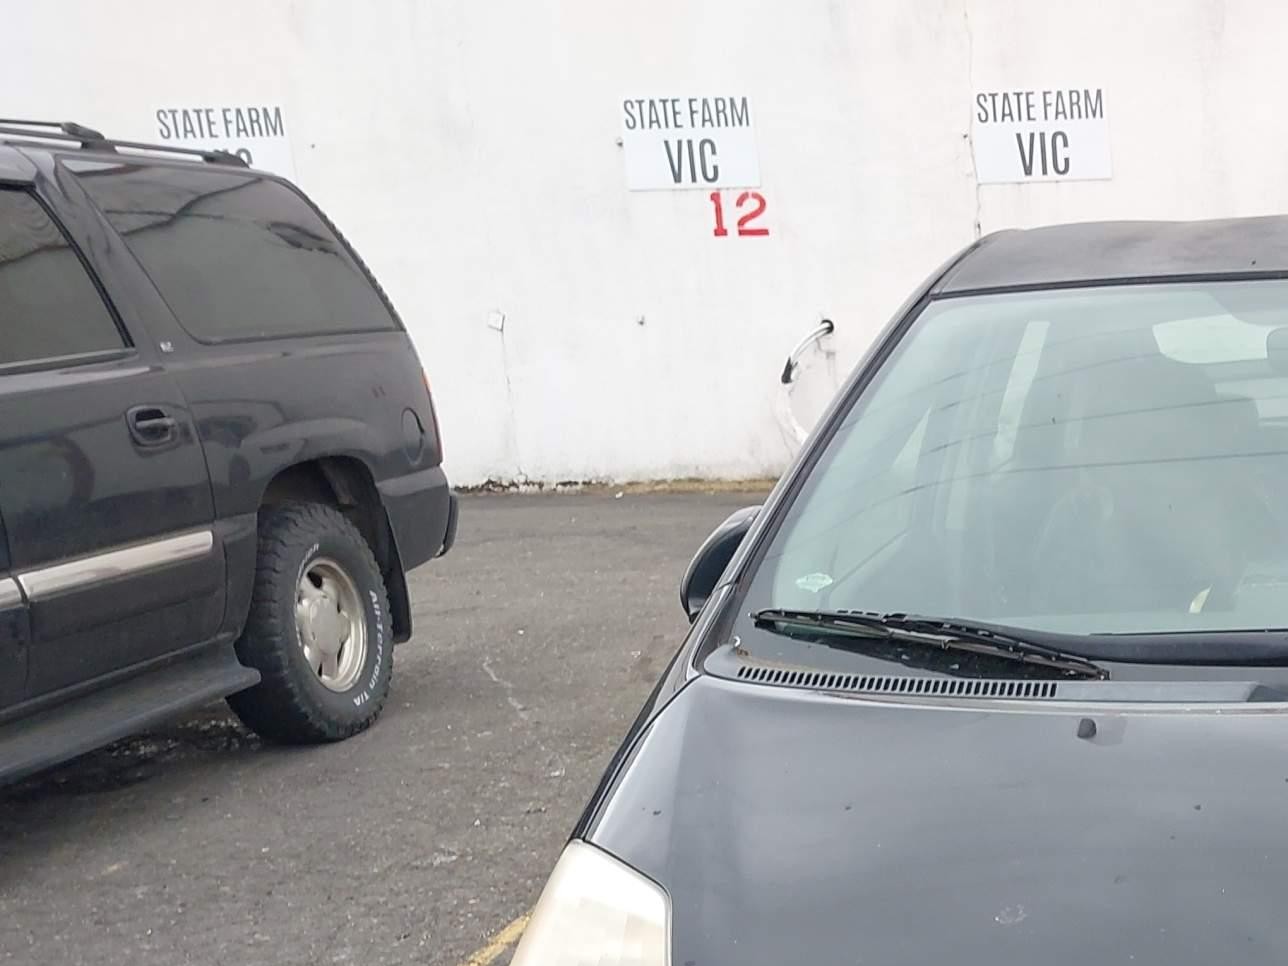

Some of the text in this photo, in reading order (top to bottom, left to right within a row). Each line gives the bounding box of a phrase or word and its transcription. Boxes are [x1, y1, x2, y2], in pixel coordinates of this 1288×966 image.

[156, 106, 285, 140] STATE FARM
[623, 96, 750, 130] STATE FARM
[976, 88, 1104, 124] STATE FARM
[663, 138, 719, 184] VIC
[1016, 130, 1070, 177] VIC
[709, 191, 769, 238] 12
